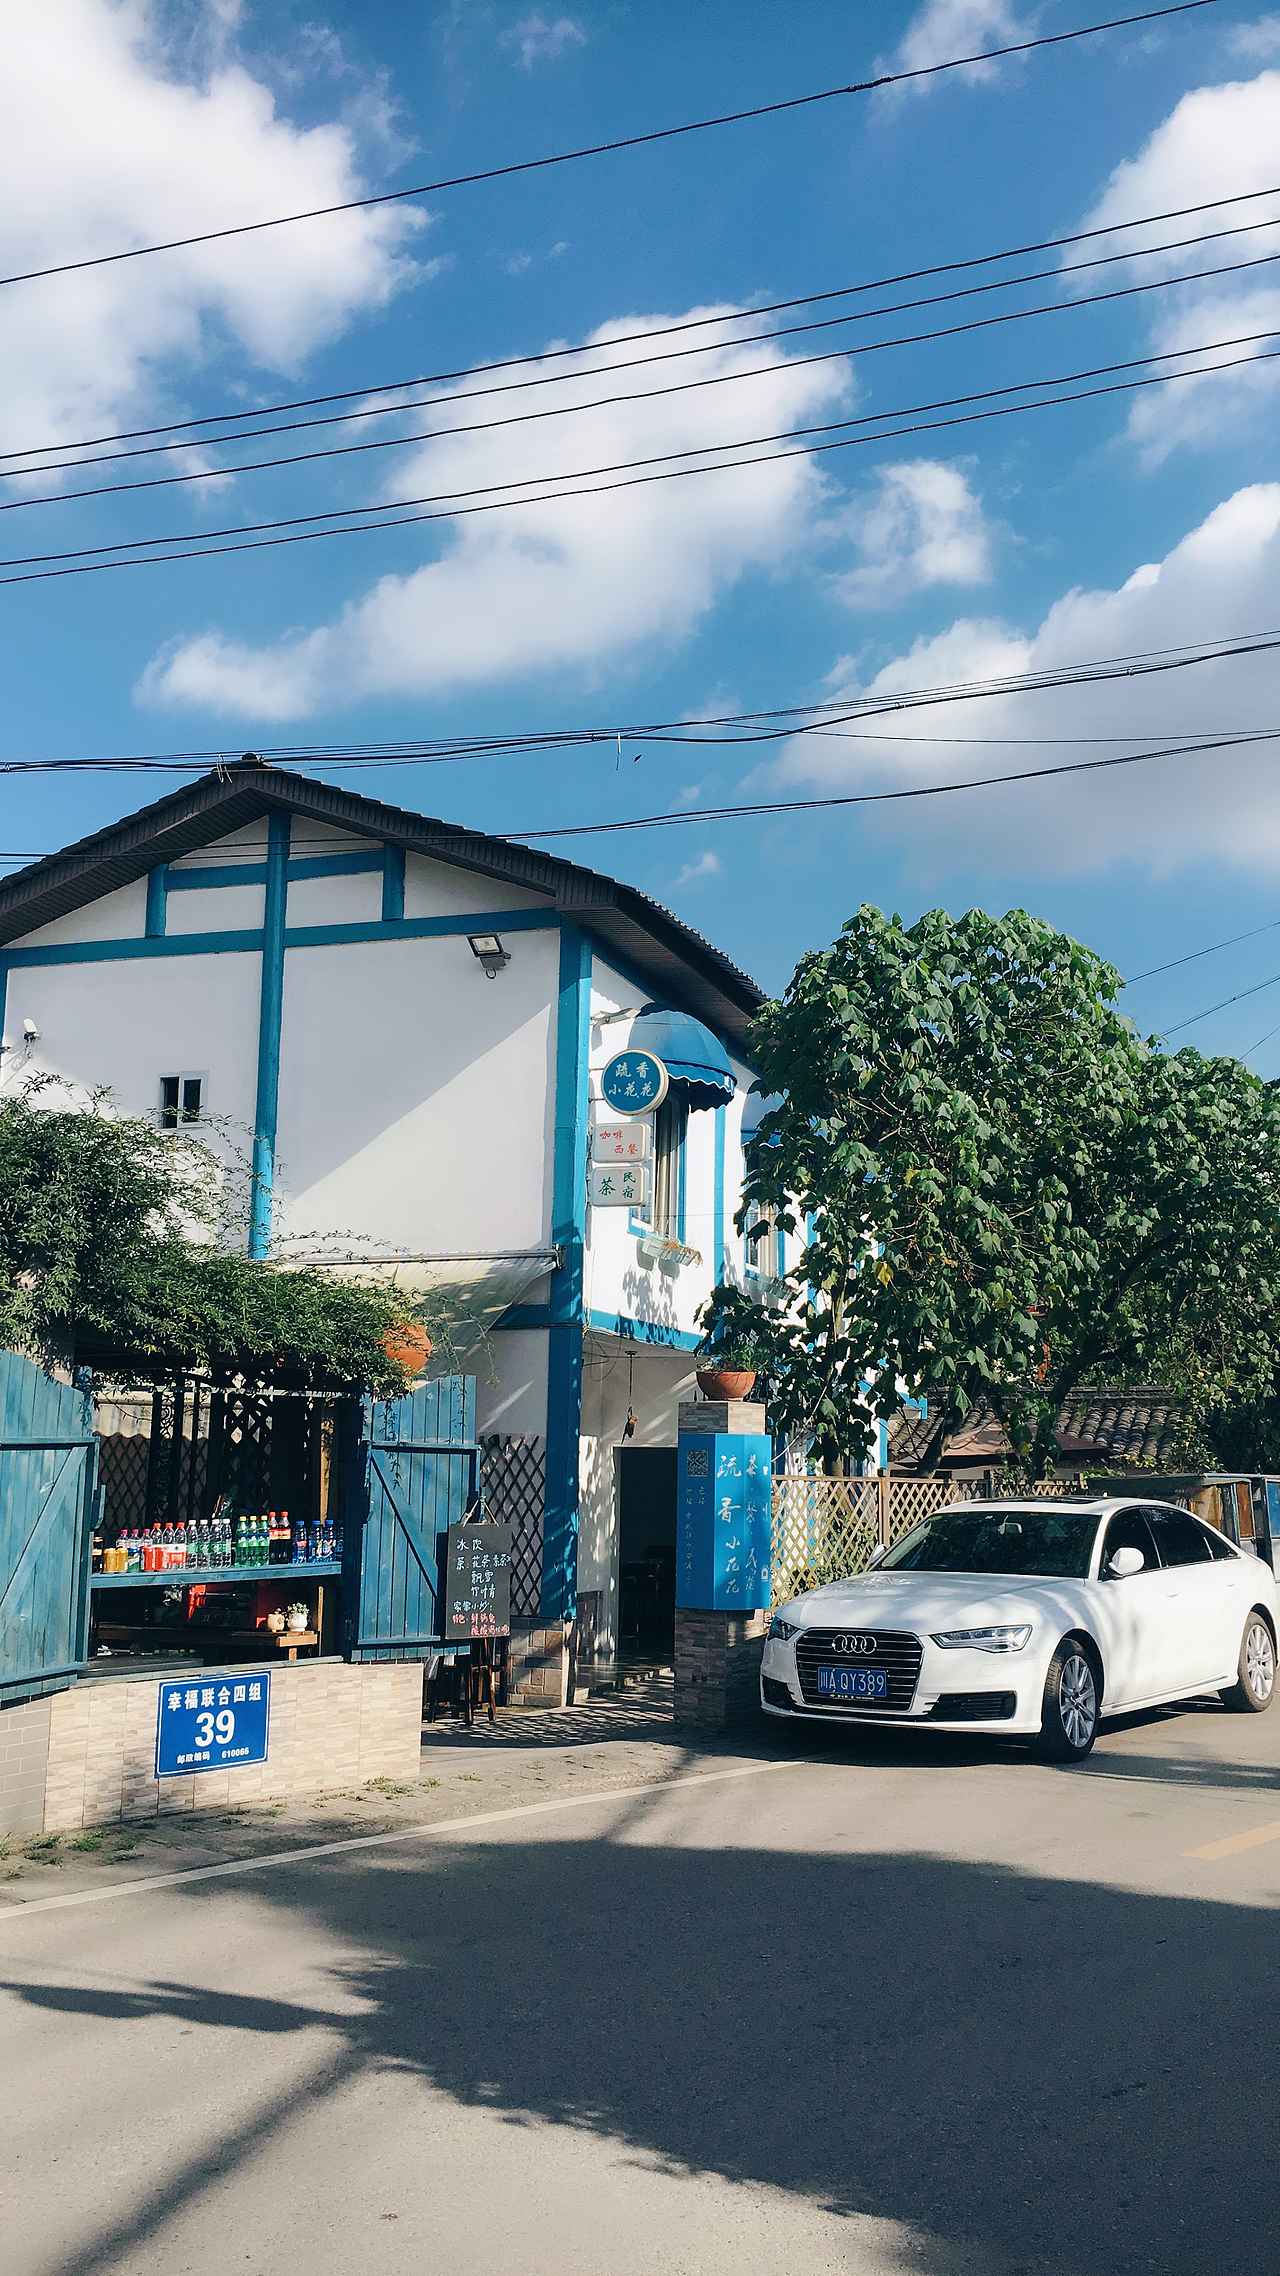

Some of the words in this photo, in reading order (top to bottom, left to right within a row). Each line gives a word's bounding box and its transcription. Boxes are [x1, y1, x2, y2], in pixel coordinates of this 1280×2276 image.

[608, 1080, 654, 1098] 小花花
[599, 1130, 623, 1140] 咖啡
[614, 1143, 638, 1155] 西餐
[598, 1176, 616, 1196] 茶
[622, 1171, 636, 1198] 民宿
[167, 1682, 262, 1712] 幸福联合四组
[194, 1709, 236, 1748] 39
[176, 1750, 211, 1765] 邮政编码
